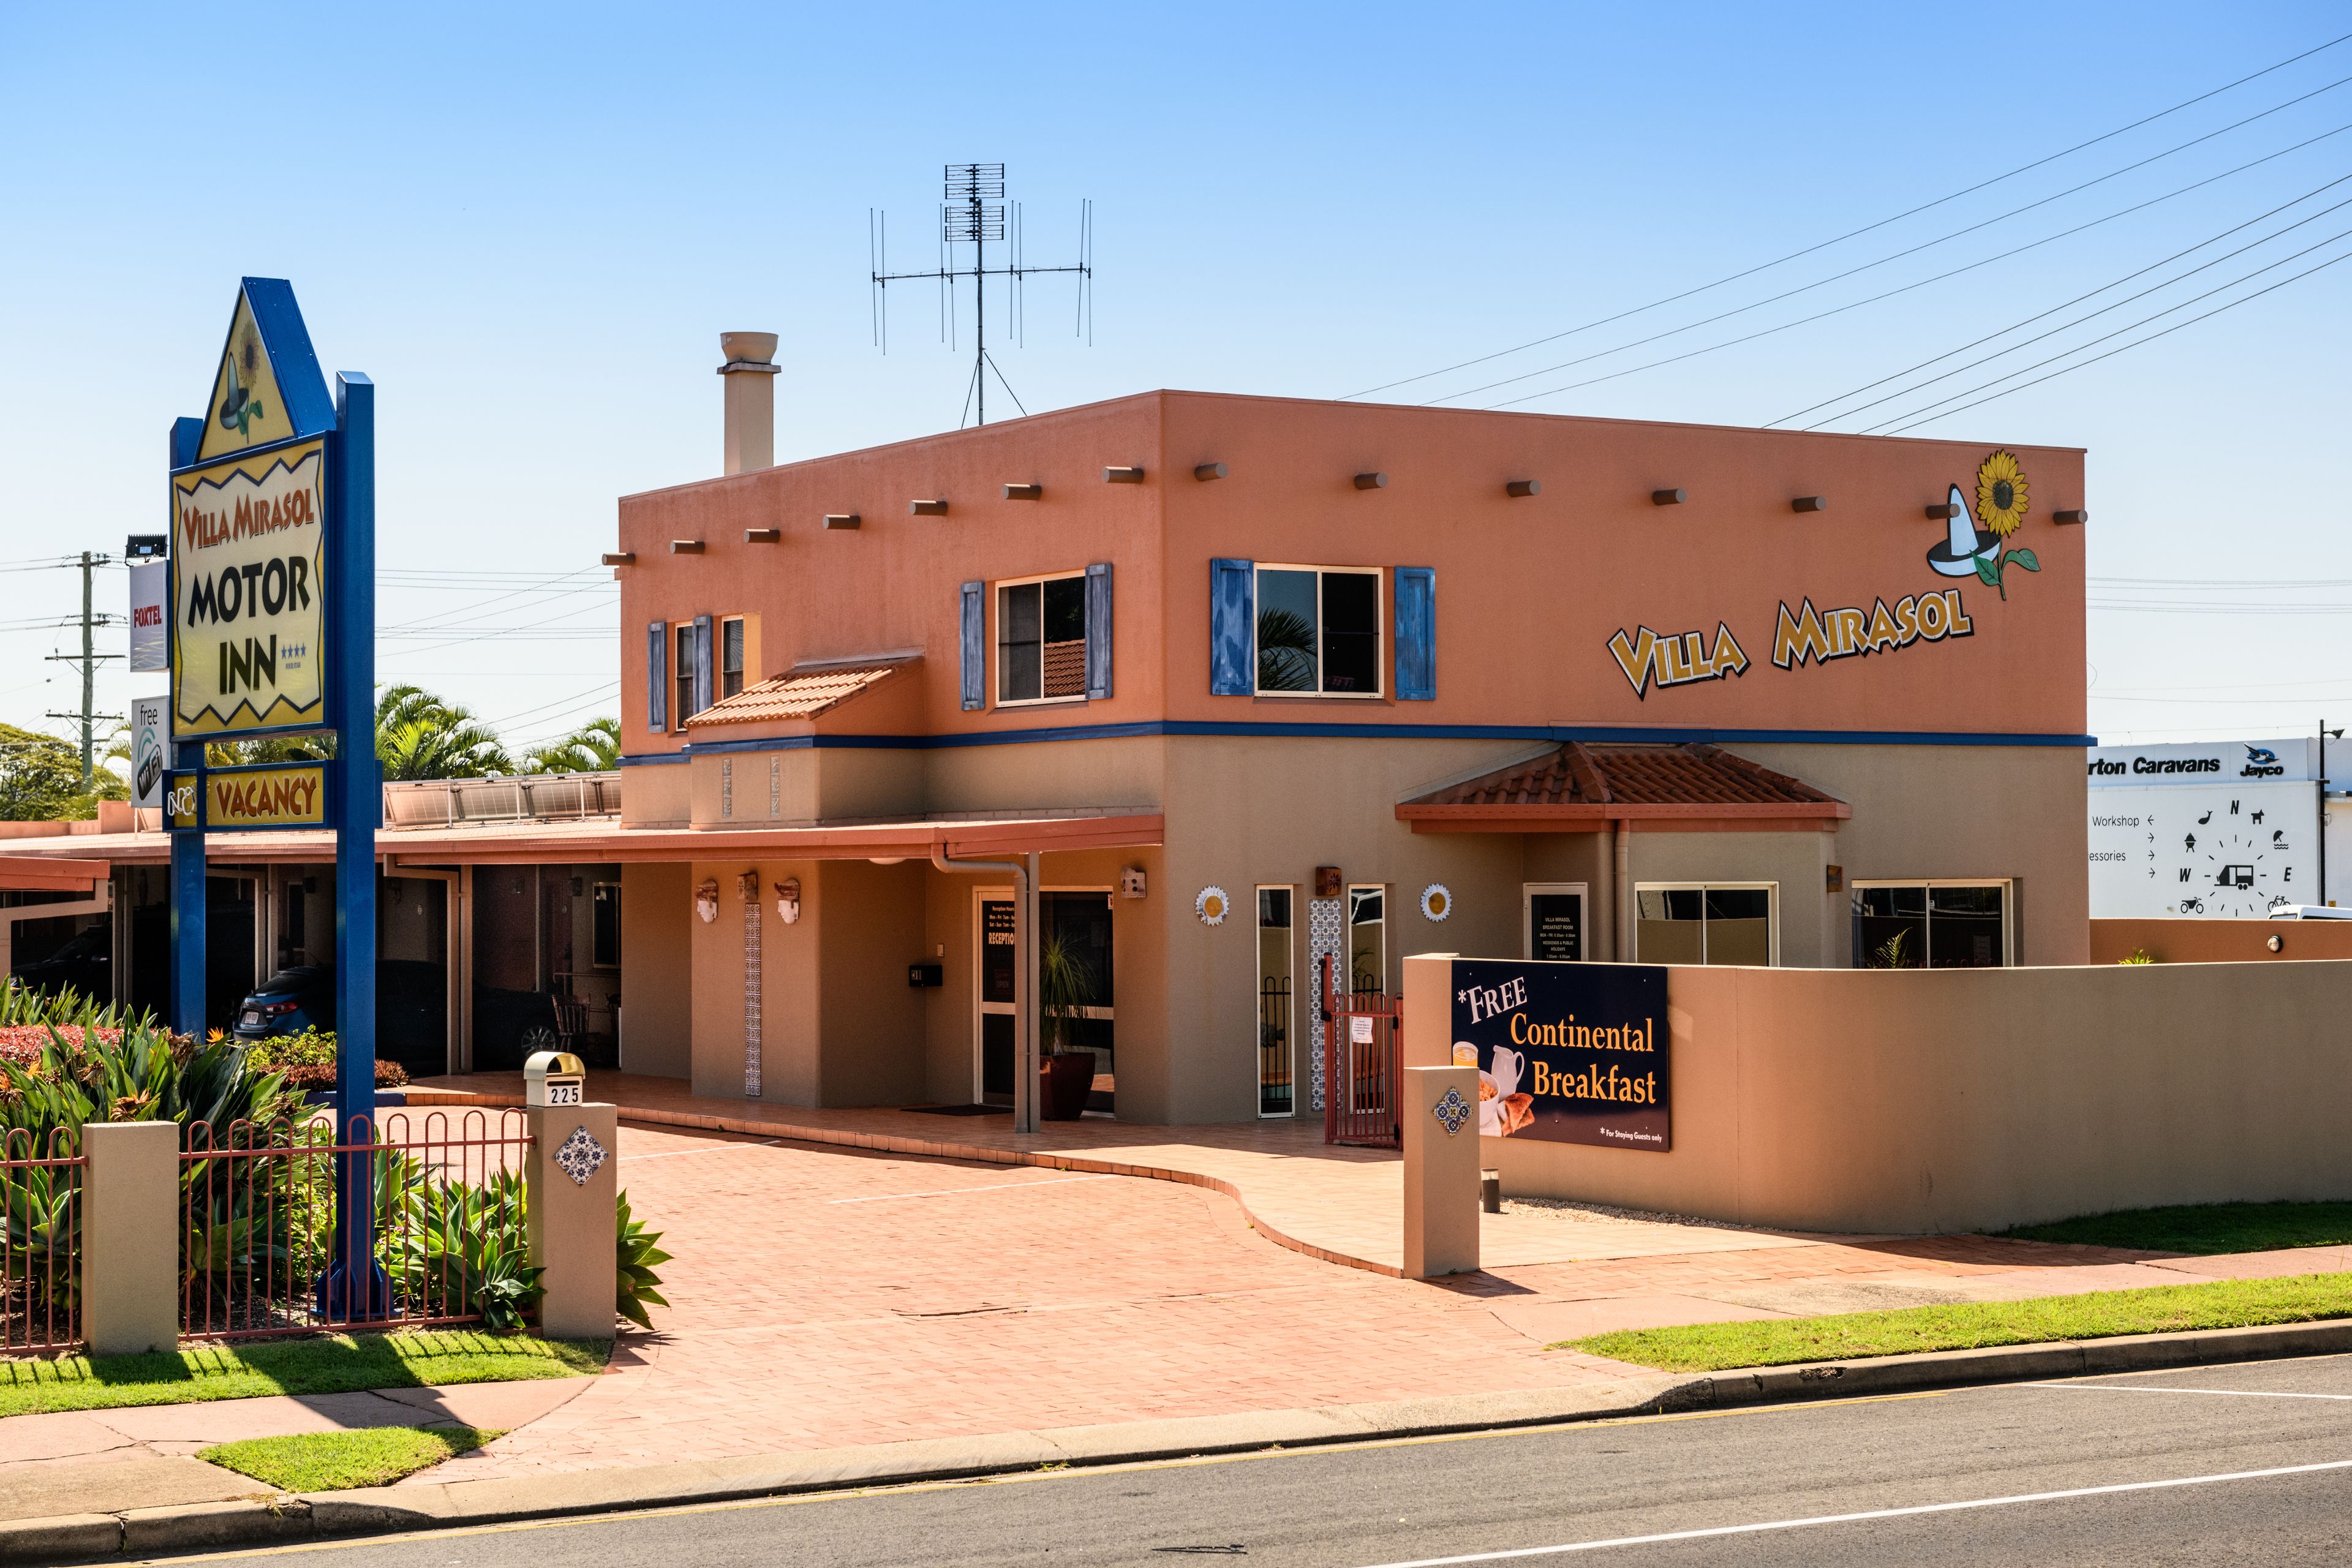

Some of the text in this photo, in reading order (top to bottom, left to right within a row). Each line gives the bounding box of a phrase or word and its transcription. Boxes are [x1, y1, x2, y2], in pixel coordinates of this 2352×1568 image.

[183, 488, 315, 552] VILLA MIRASOL
[187, 556, 311, 628] MOTOR
[134, 605, 162, 628] FOXTEL
[1607, 589, 1974, 702] VILLA MIRASOL
[219, 634, 277, 695] INN
[140, 704, 158, 726] free
[2087, 756, 2220, 775] rton Caravans
[2240, 764, 2284, 778] Jayco
[216, 775, 317, 819] VACANCY
[2230, 800, 2239, 815] N
[2092, 816, 2139, 828] Workshop
[2089, 850, 2126, 862] essories
[2179, 868, 2192, 882] W
[2284, 867, 2292, 881] E
[989, 932, 1015, 945] RECEPTIO
[1510, 1012, 1654, 1052] Continental
[1532, 1061, 1656, 1104] Breakfast
[551, 1088, 578, 1103] 225
[1615, 1130, 1634, 1140] Staying
[1634, 1132, 1651, 1140] Guests
[1651, 1134, 1662, 1143] only
